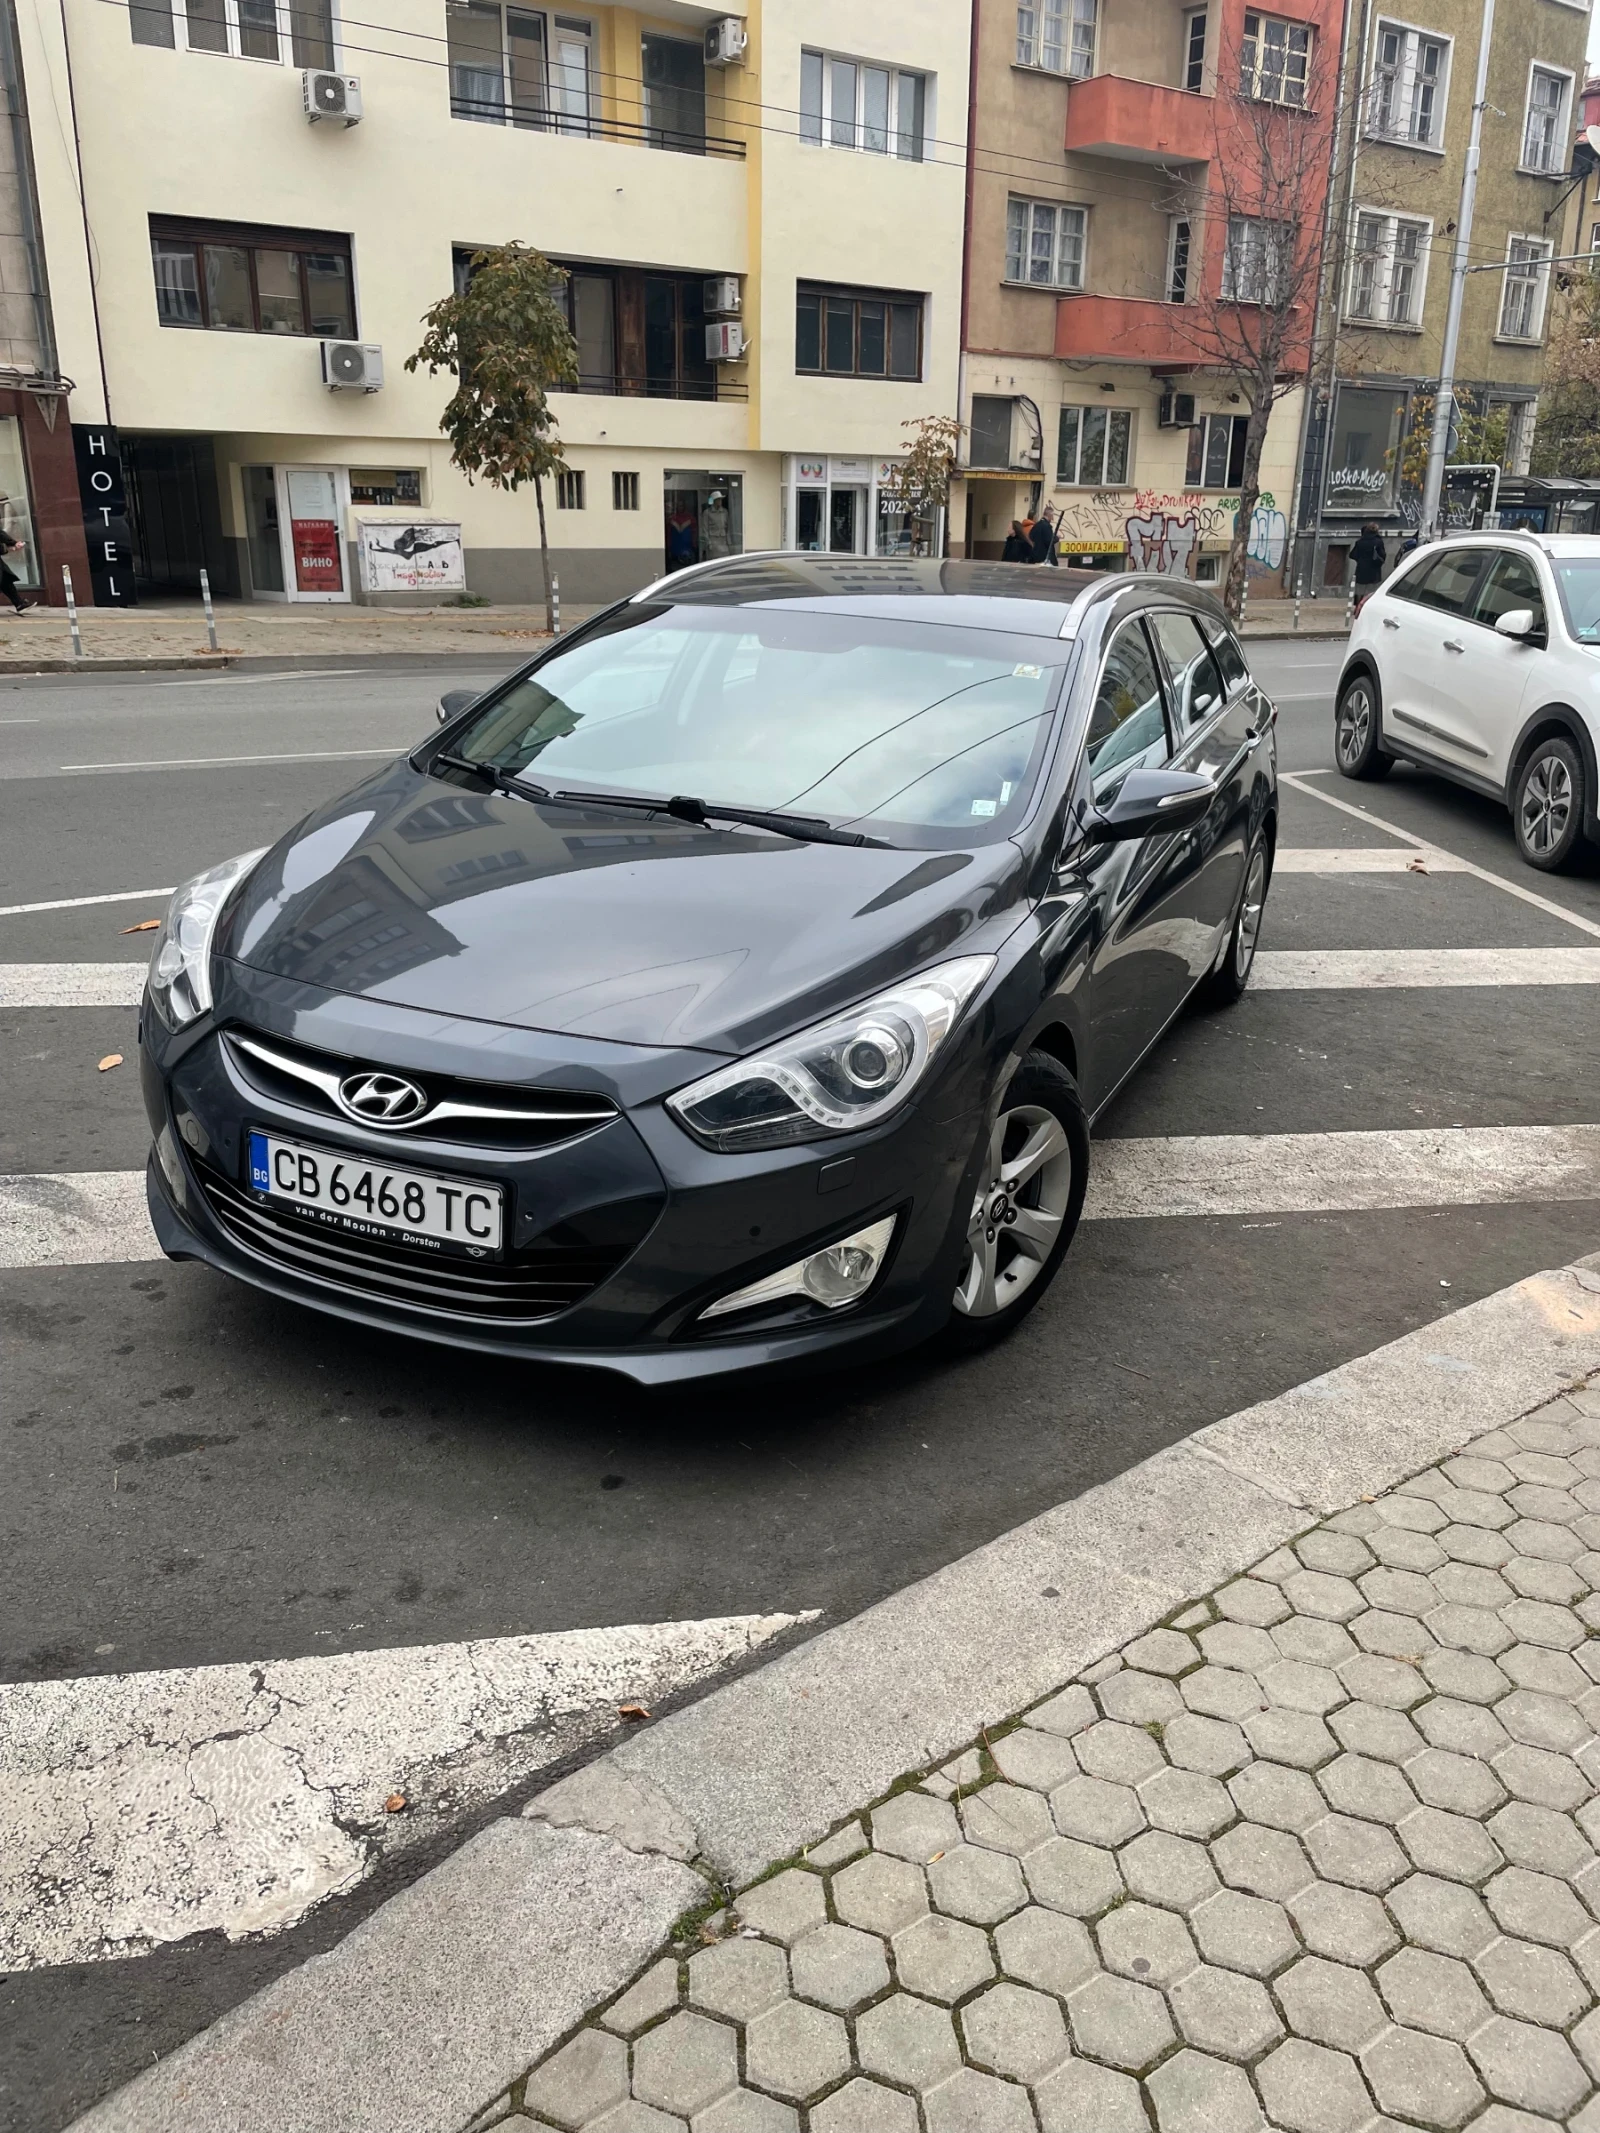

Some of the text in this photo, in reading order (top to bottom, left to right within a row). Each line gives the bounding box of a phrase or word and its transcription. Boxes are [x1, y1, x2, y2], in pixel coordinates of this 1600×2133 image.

[88, 435, 121, 596] HOTEL
[1065, 542, 1118, 553] ЗООМАГАЗИН
[301, 557, 333, 568] ВИНО
[253, 1167, 268, 1183] BG
[274, 1148, 492, 1238] CB 6468 TC
[295, 1206, 441, 1249] van der Moolen Dorsten
